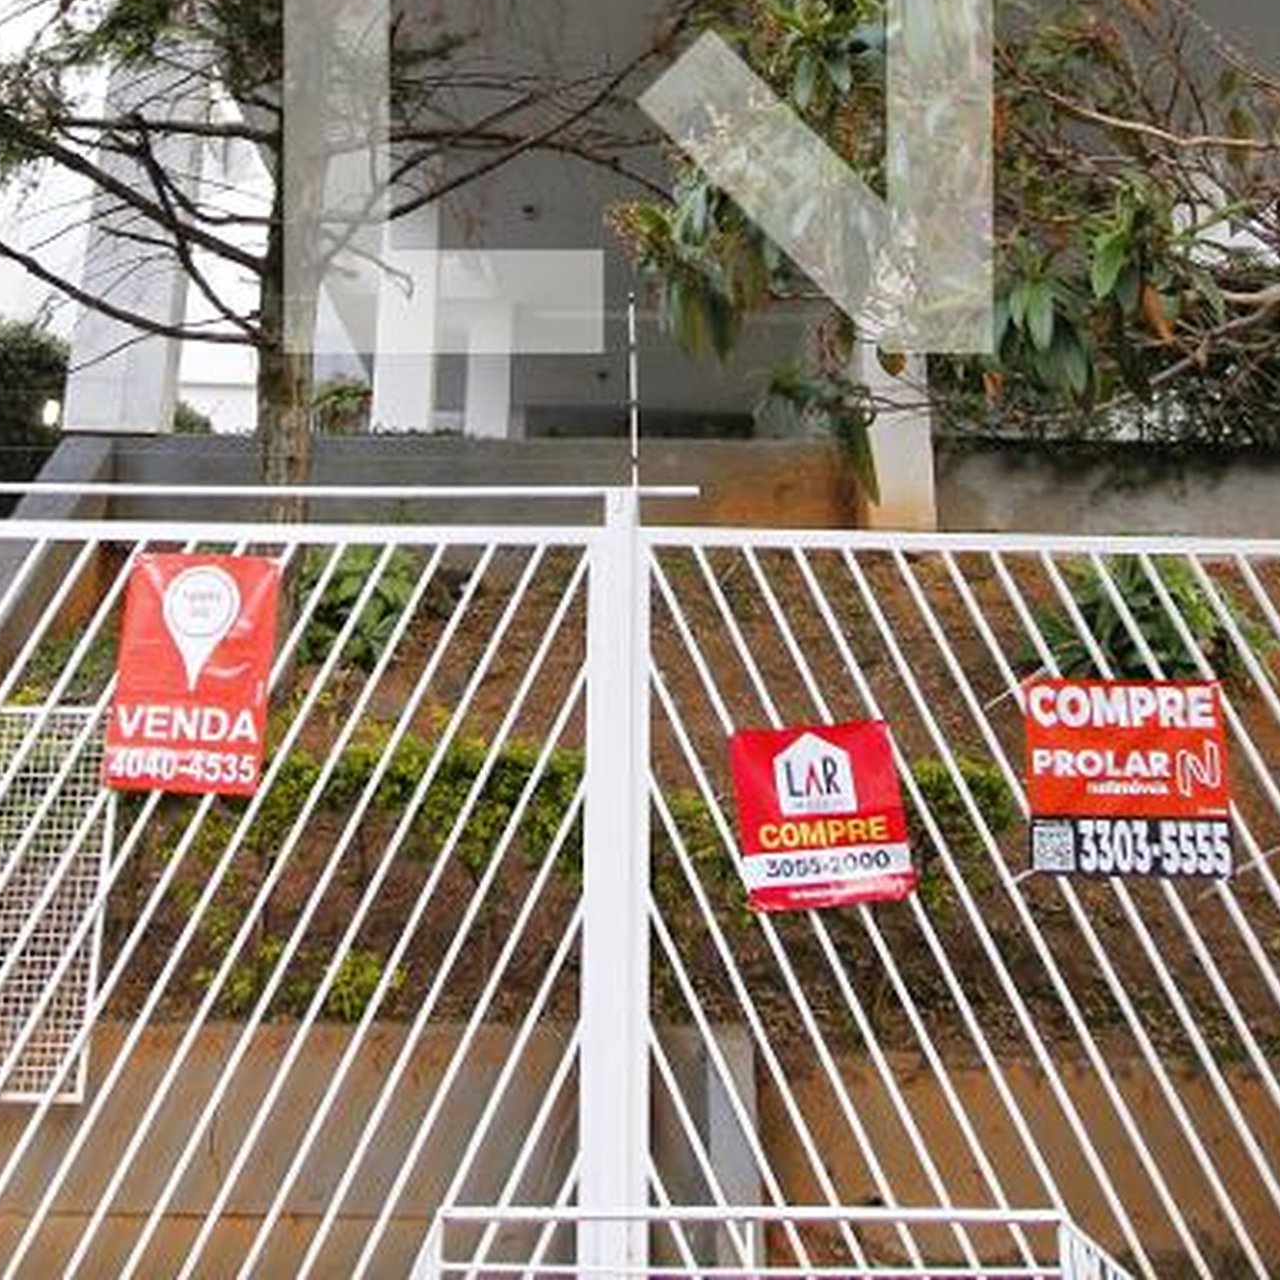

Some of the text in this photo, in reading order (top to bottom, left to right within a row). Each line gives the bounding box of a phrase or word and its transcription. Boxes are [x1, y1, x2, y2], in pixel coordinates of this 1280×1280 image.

[118, 705, 258, 743] VENDA
[1029, 685, 1216, 728] COMPRE
[108, 747, 256, 784] 4040-4535
[785, 756, 841, 798] LAR
[1032, 749, 1170, 778] PROLAR
[759, 816, 889, 849] COMPRE
[1078, 819, 1232, 876] 3303-5555
